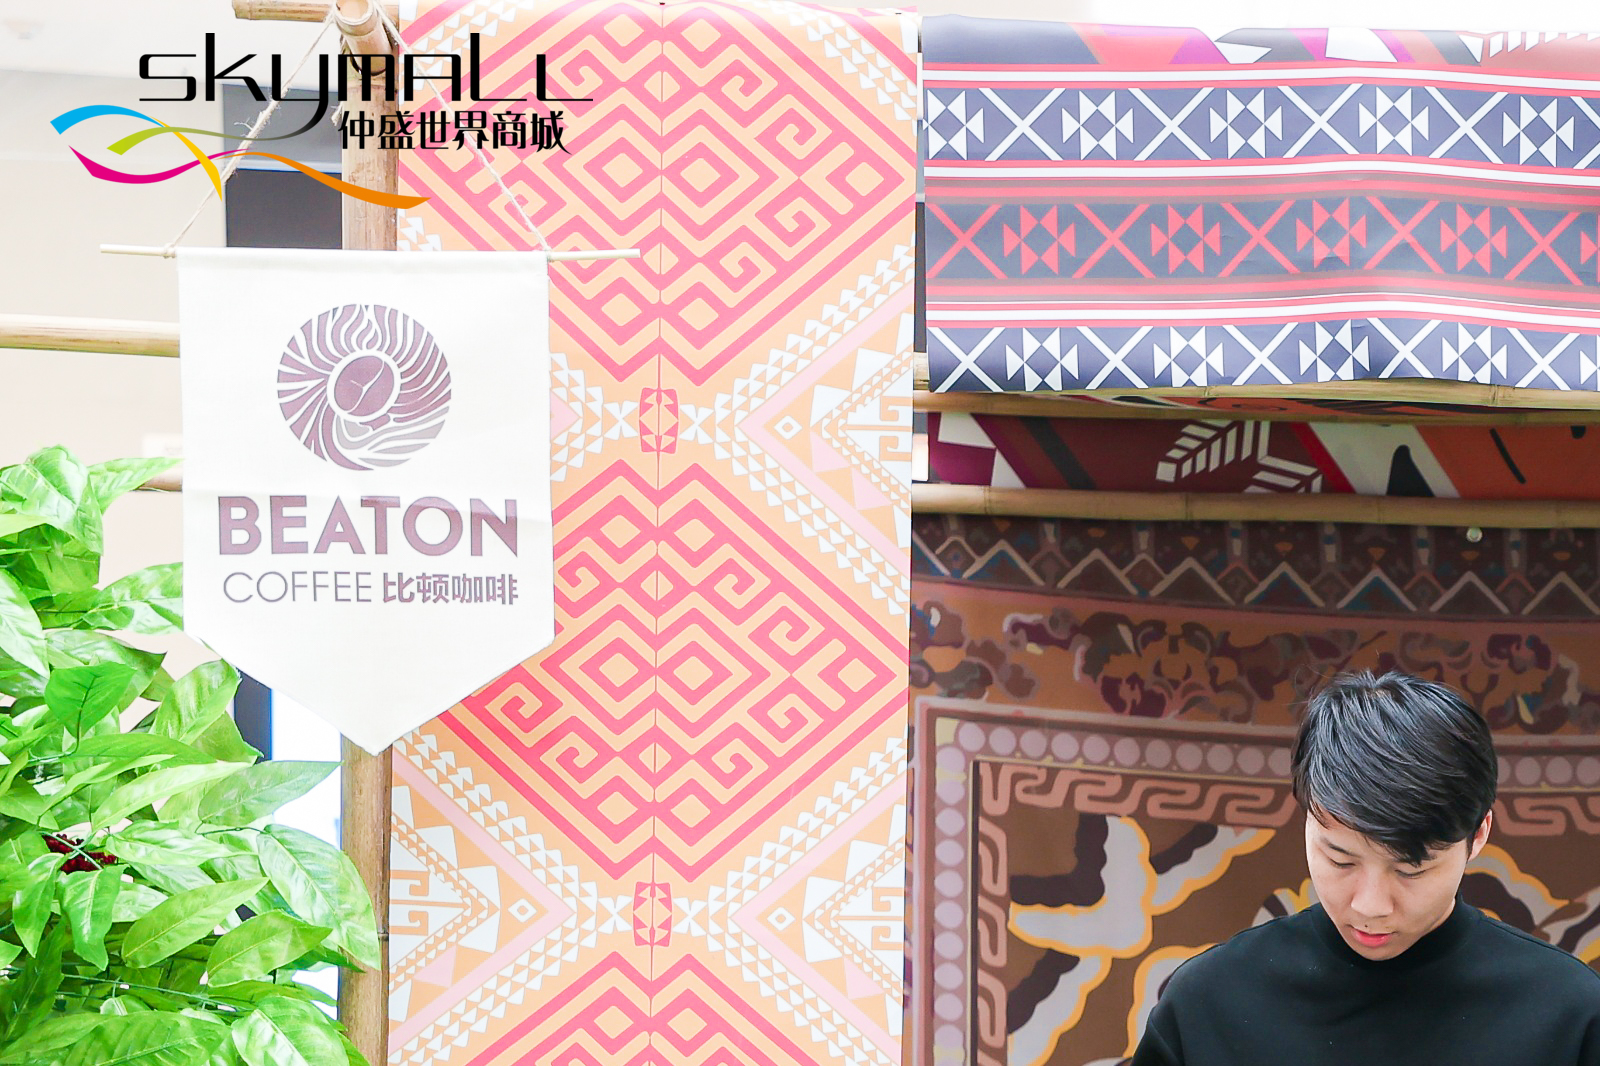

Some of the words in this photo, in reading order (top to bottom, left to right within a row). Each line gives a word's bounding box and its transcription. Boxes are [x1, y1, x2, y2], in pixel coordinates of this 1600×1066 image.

[217, 495, 518, 558] BEATON
[223, 571, 372, 603] COFFEE
[381, 571, 518, 606] 比顿咖啡
